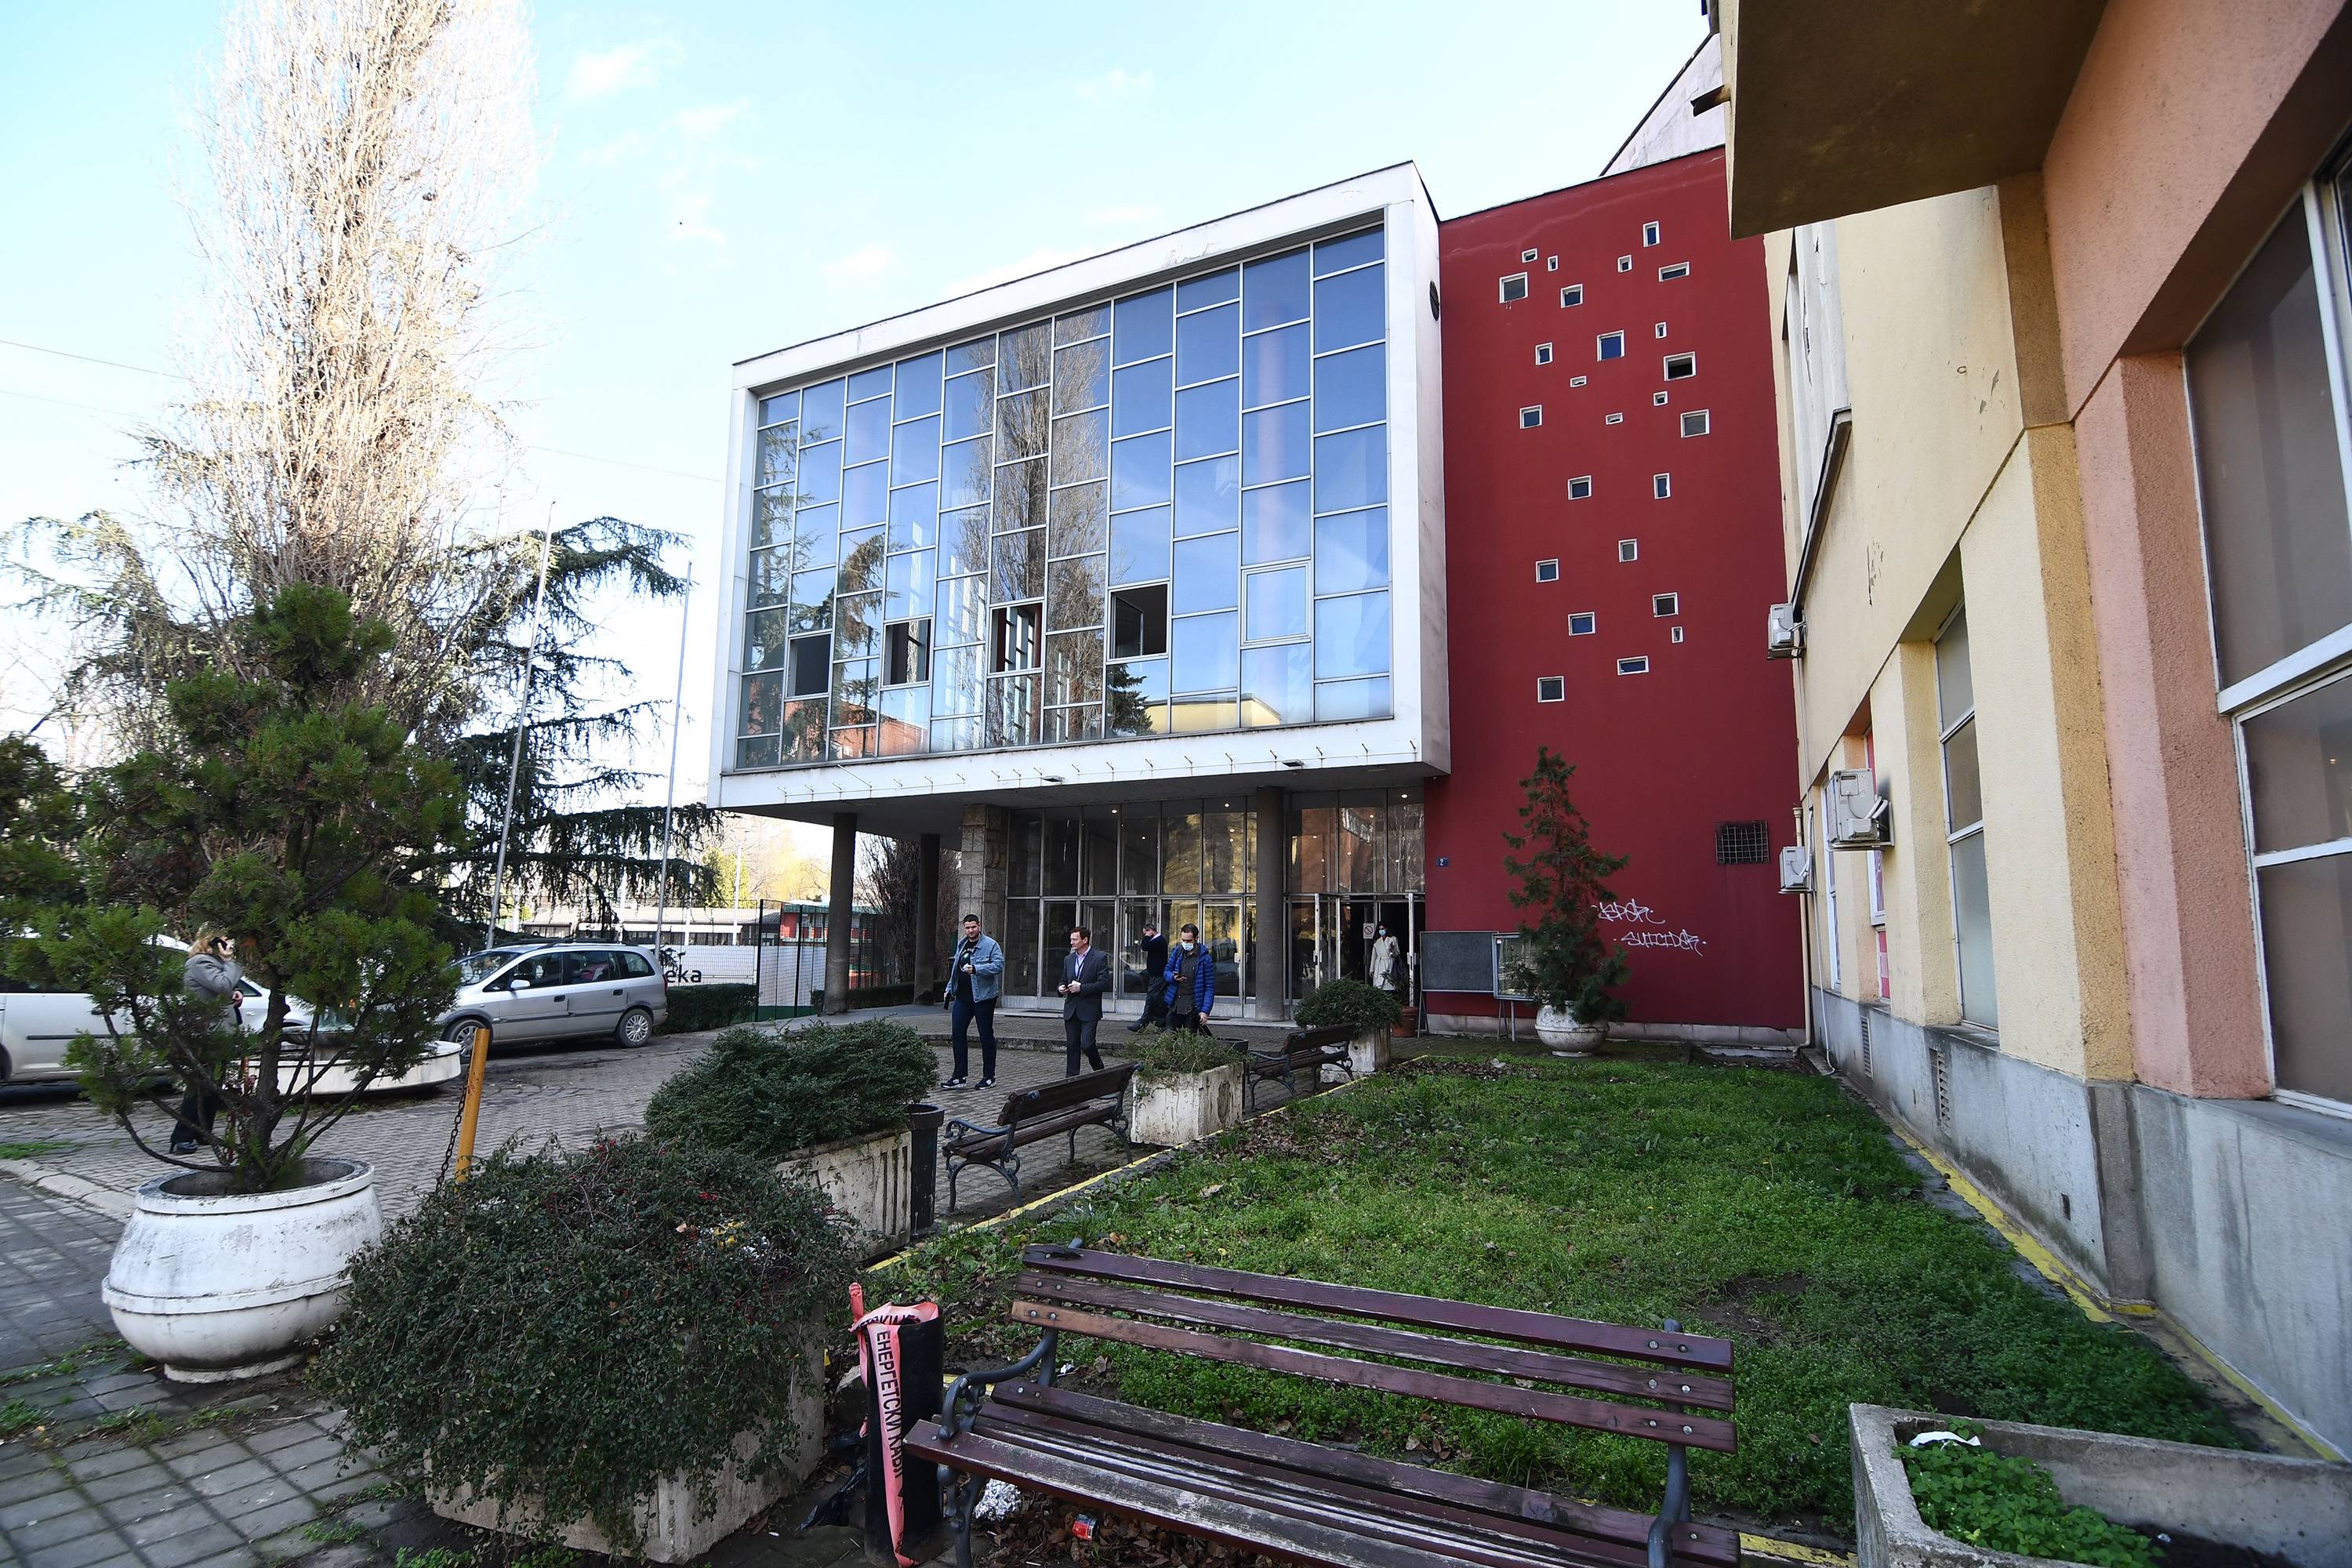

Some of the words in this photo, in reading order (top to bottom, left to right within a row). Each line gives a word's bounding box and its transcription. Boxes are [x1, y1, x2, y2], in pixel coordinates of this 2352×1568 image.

[1439, 858, 1444, 866] 2
[665, 964, 702, 983] eka
[877, 1330, 902, 1432] ЕНЕРГЕТСКИ
